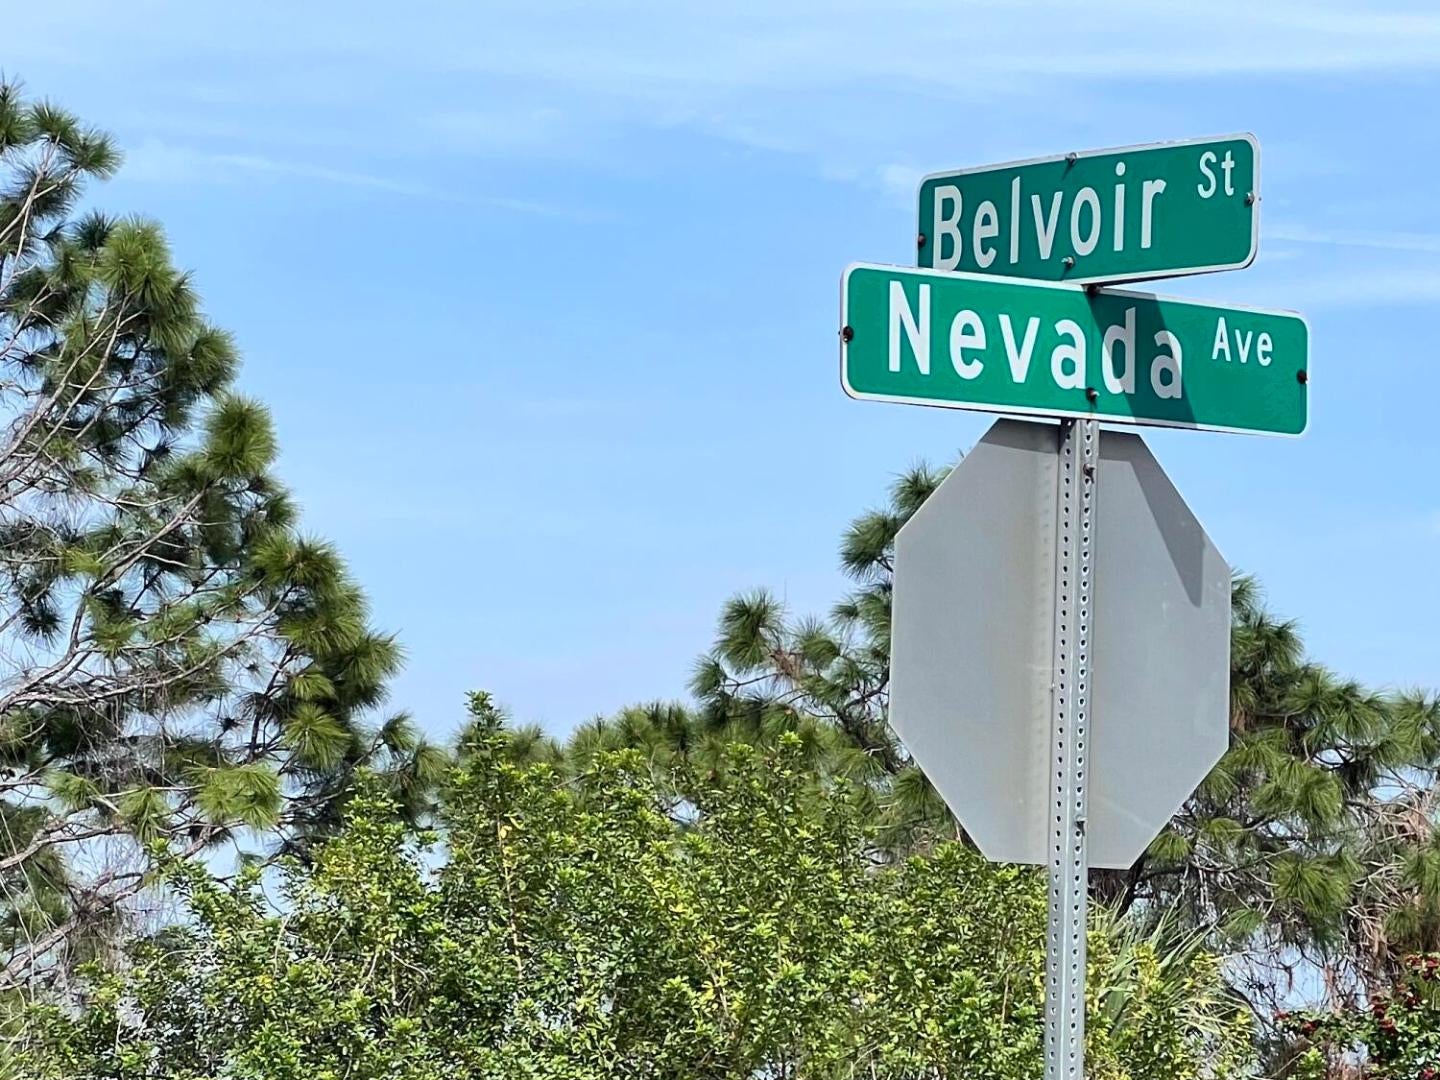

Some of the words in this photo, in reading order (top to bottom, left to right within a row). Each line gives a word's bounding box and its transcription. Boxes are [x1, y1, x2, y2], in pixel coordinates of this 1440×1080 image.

[932, 161, 1167, 272] Belvoir
[1197, 150, 1235, 199] St
[888, 280, 1183, 400] Nevada
[1211, 316, 1273, 367] Ave
